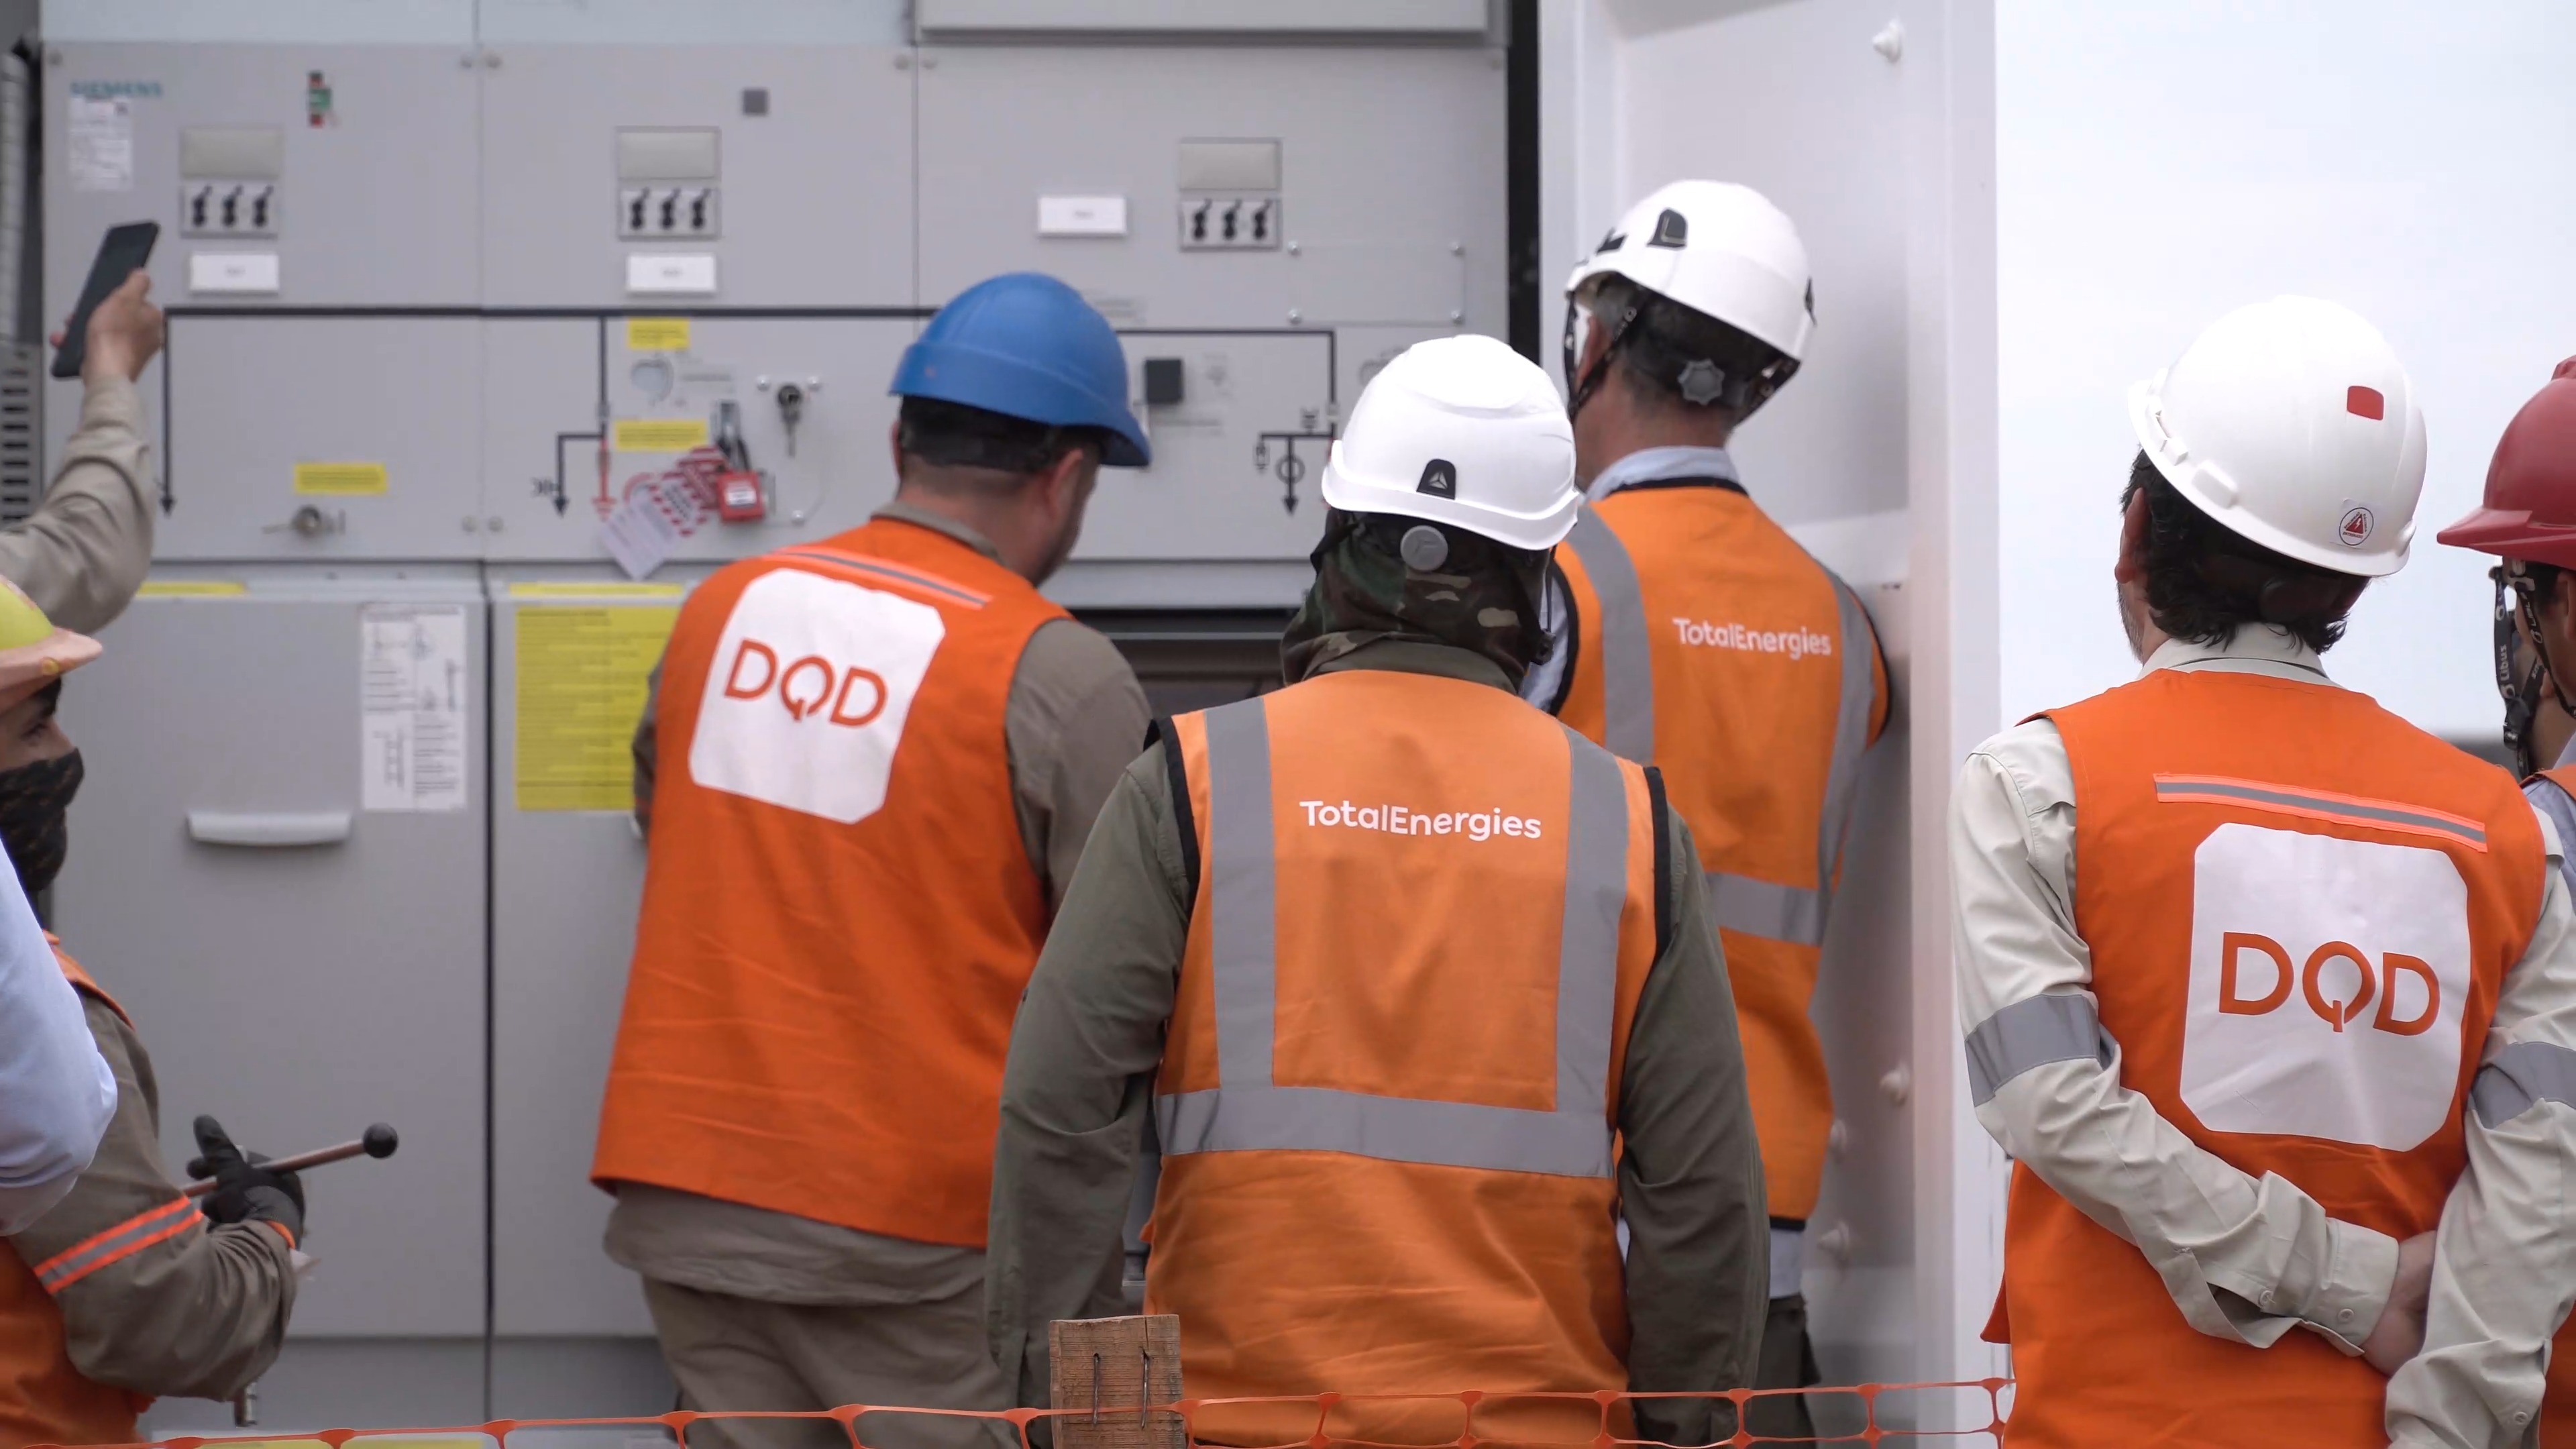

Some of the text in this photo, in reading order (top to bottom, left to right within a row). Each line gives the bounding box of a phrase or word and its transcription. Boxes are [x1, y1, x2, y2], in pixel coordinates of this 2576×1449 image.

[1672, 616, 1831, 660] TotalEnergies
[724, 639, 888, 728] DQD
[2500, 644, 2511, 681] Libus
[1299, 800, 1542, 842] TotalEnergies
[2218, 932, 2440, 1036] DQD
